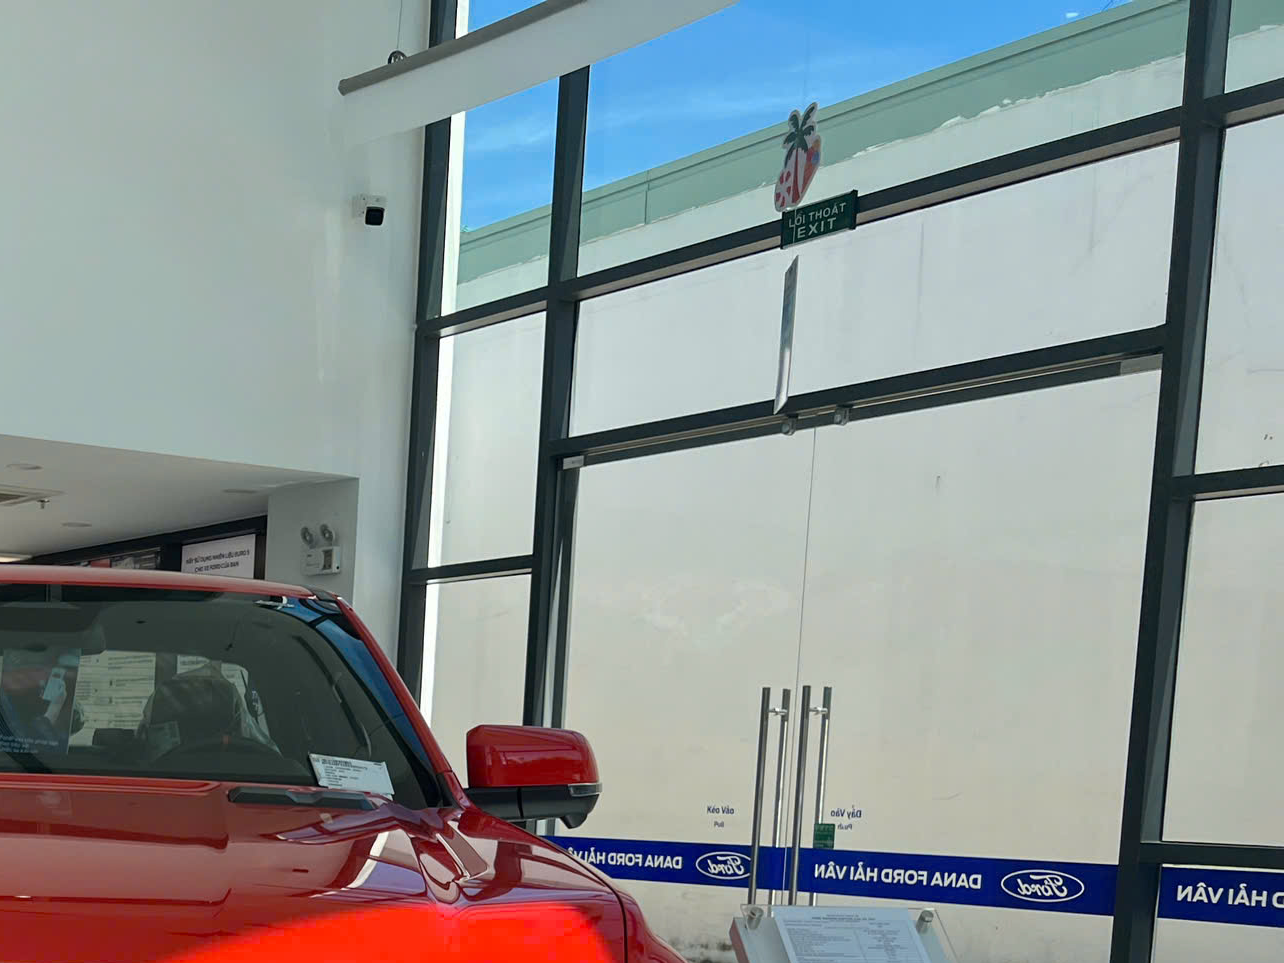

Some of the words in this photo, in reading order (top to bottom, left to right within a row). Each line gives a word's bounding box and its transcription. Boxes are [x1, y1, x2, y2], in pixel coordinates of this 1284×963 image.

[808, 201, 847, 222] THOÁT
[797, 217, 837, 239] EXIT
[706, 804, 720, 815] Kéo
